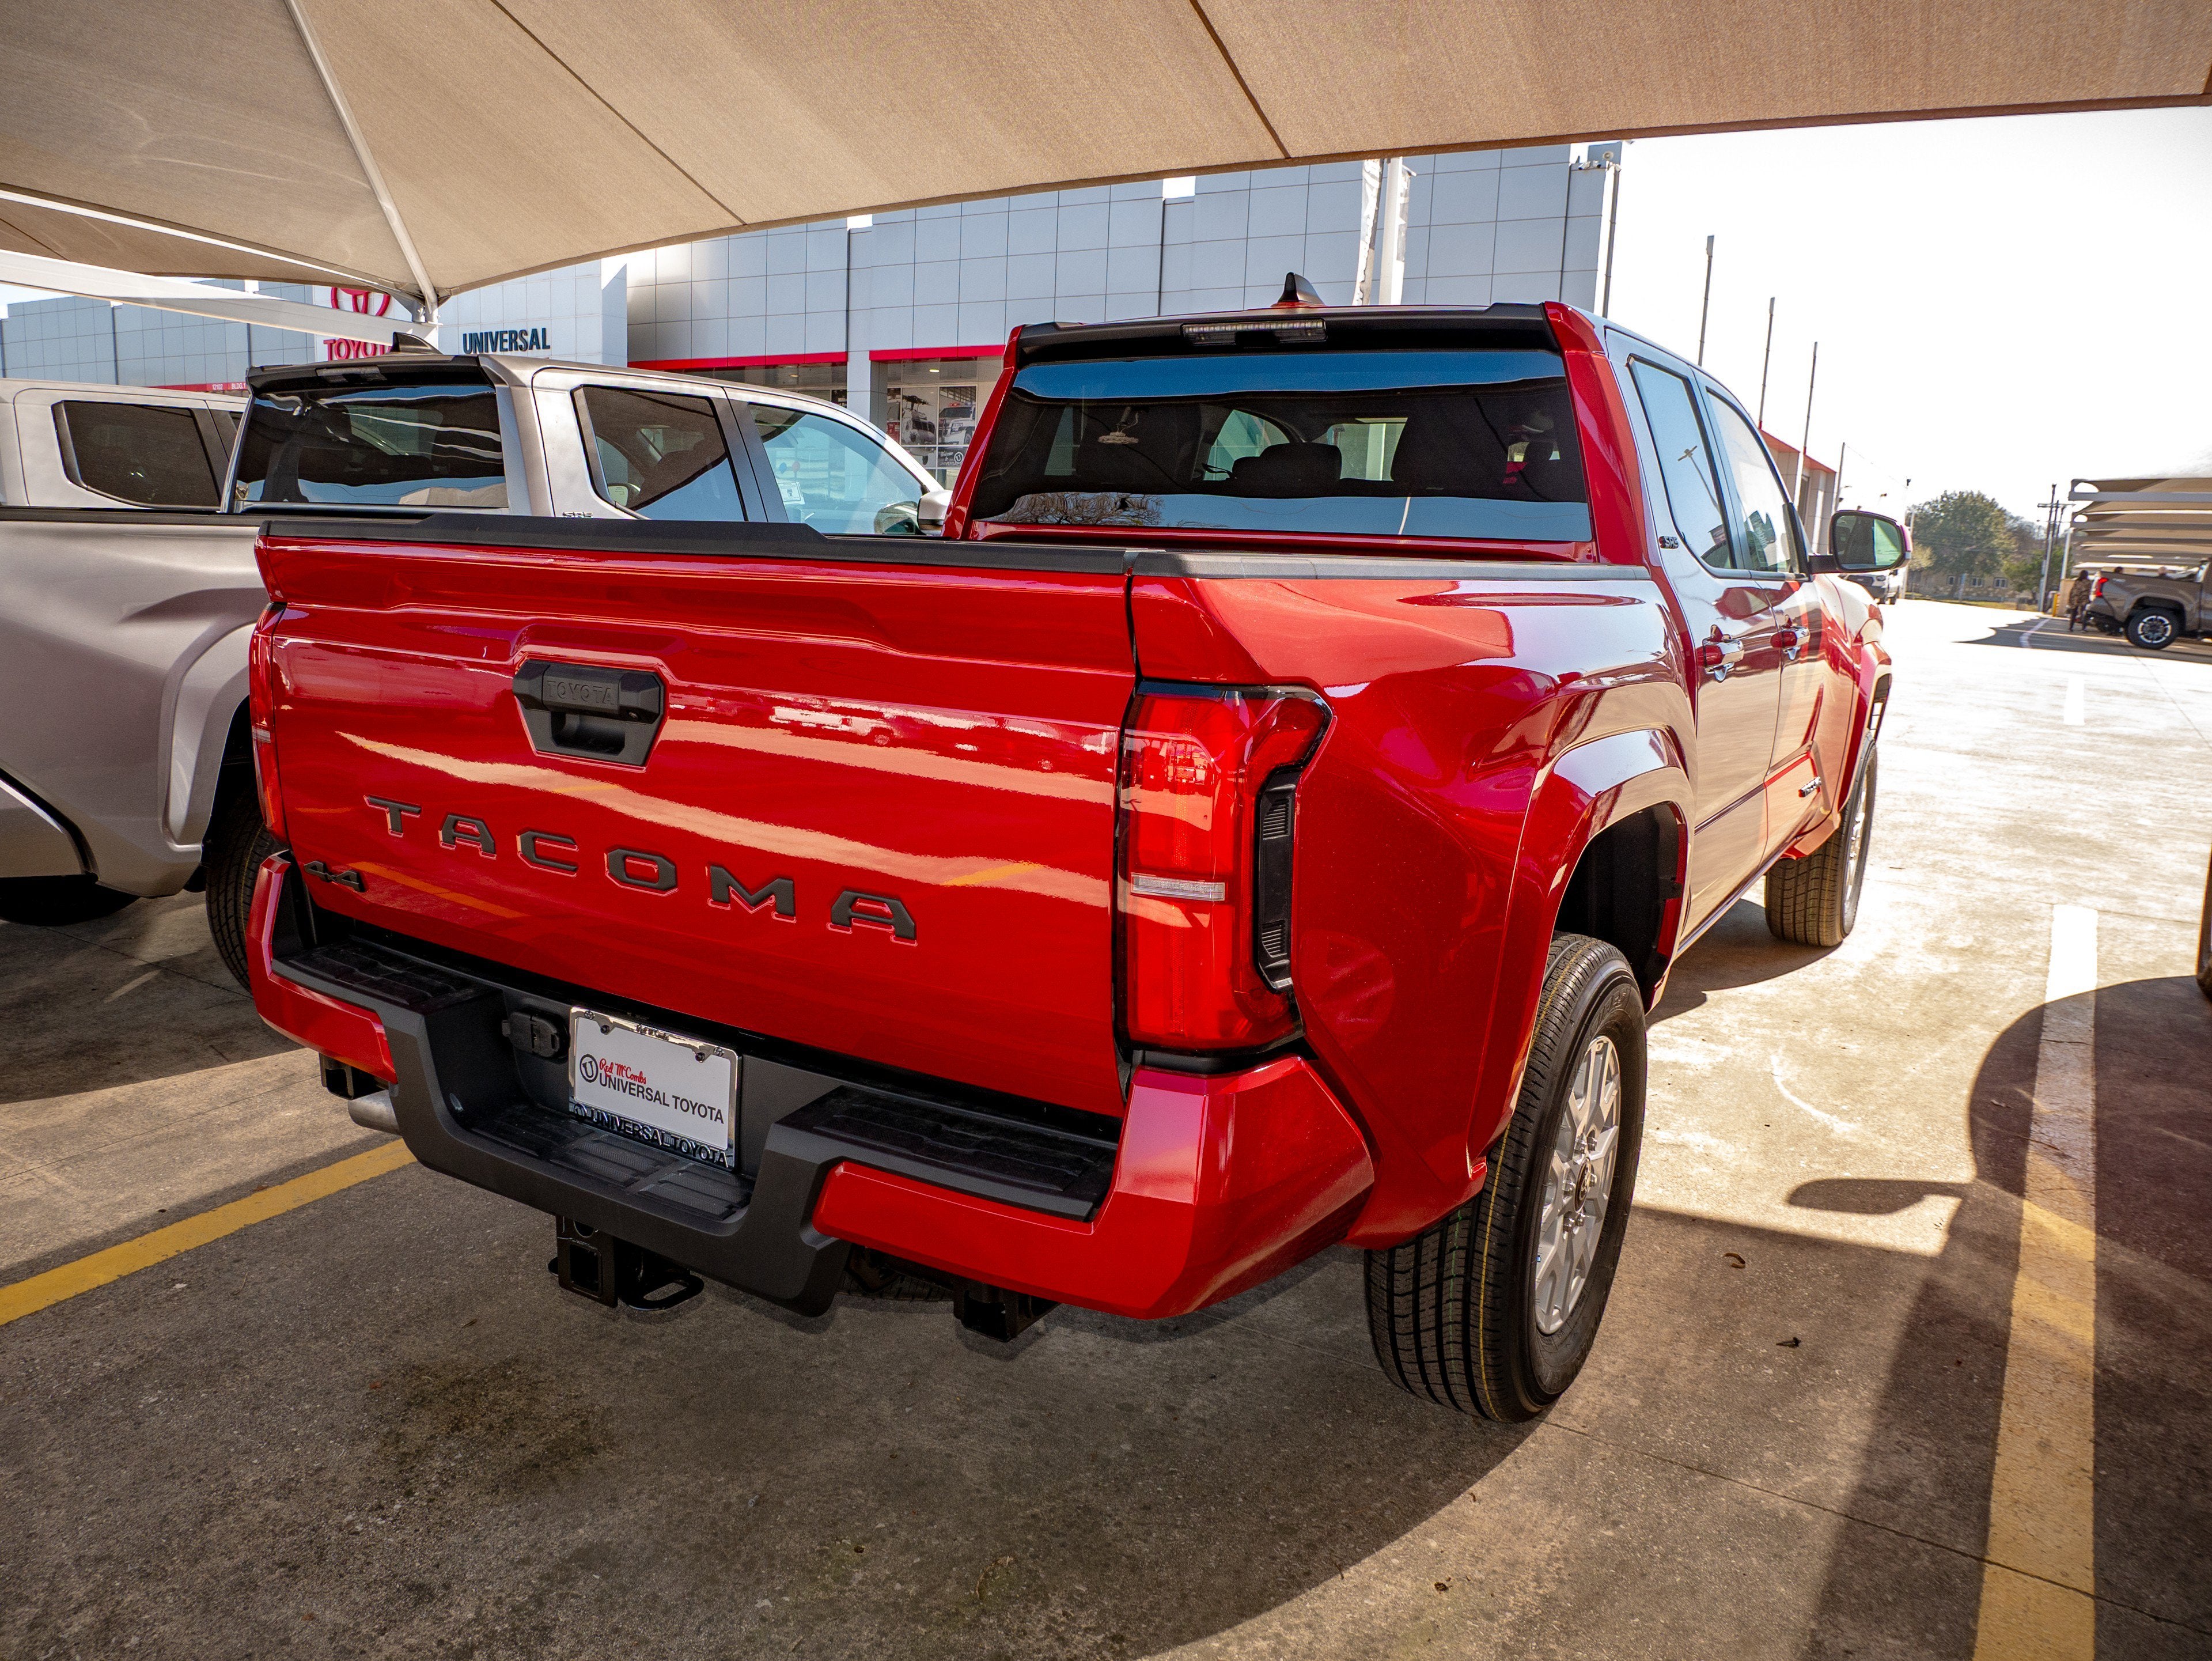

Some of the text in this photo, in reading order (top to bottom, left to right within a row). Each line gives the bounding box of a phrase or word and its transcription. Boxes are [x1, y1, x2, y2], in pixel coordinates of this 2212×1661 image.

[323, 338, 392, 361] TOYO
[463, 328, 550, 354] UNIVERSAL
[547, 680, 615, 705] TOYOTA
[365, 794, 917, 945] TACOMA
[599, 1058, 647, 1085] Red McCombs
[599, 1072, 725, 1124] UNIVERSAL TOYOTA
[591, 1107, 670, 1147] UNIVERSAL
[671, 1134, 729, 1168] TOYOTA
